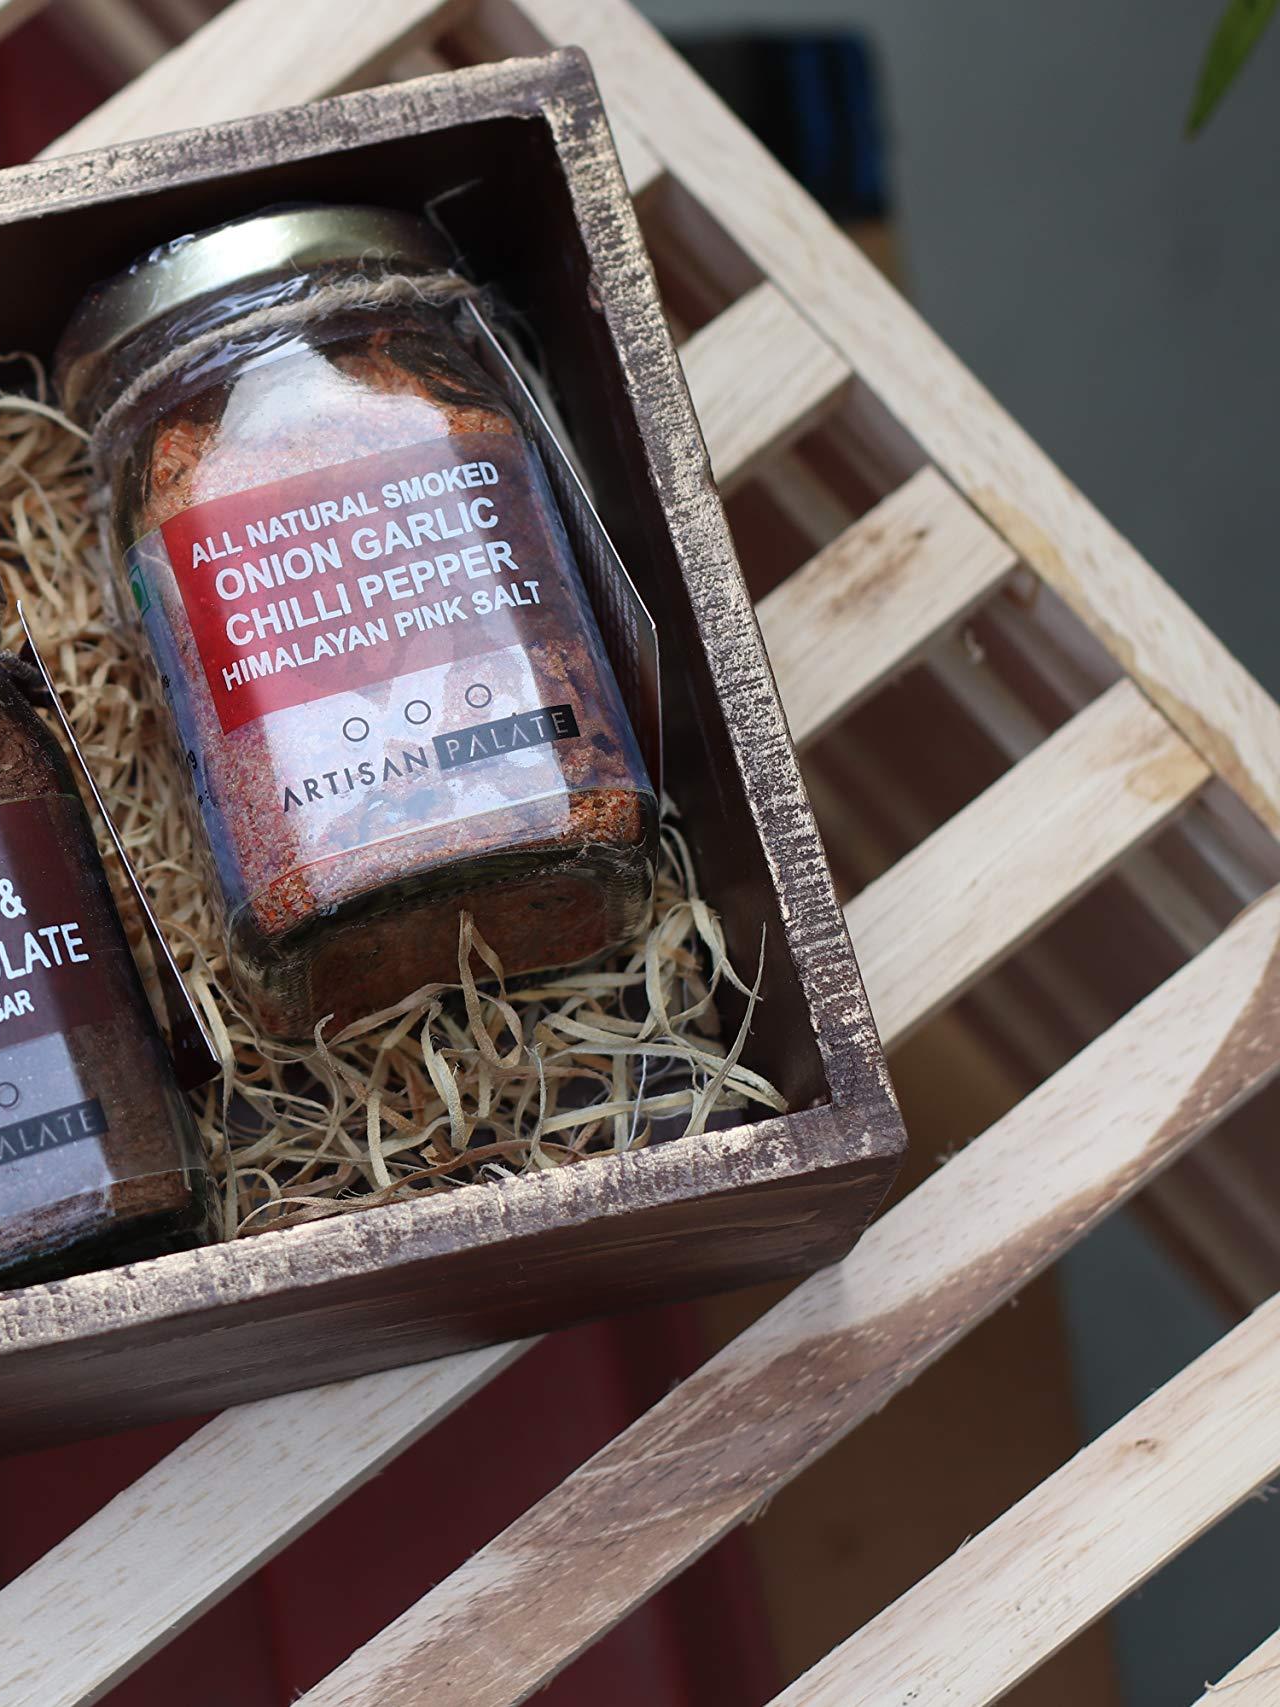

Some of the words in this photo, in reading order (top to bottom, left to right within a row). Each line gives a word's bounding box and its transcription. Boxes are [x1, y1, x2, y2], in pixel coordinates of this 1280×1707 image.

[191, 531, 243, 569] ALL
[245, 491, 379, 549] NATURAL
[381, 461, 499, 509] SMOKED
[214, 537, 343, 601] ONION
[351, 497, 499, 561] GARLIC
[222, 619, 389, 691] HIMALAYAN
[400, 595, 468, 638] PINK
[473, 581, 542, 616] SALT
[225, 582, 352, 646] CHILLI
[359, 540, 519, 608] PEPPER
[283, 747, 430, 812] ARTISAN
[445, 712, 571, 760] PALATE
